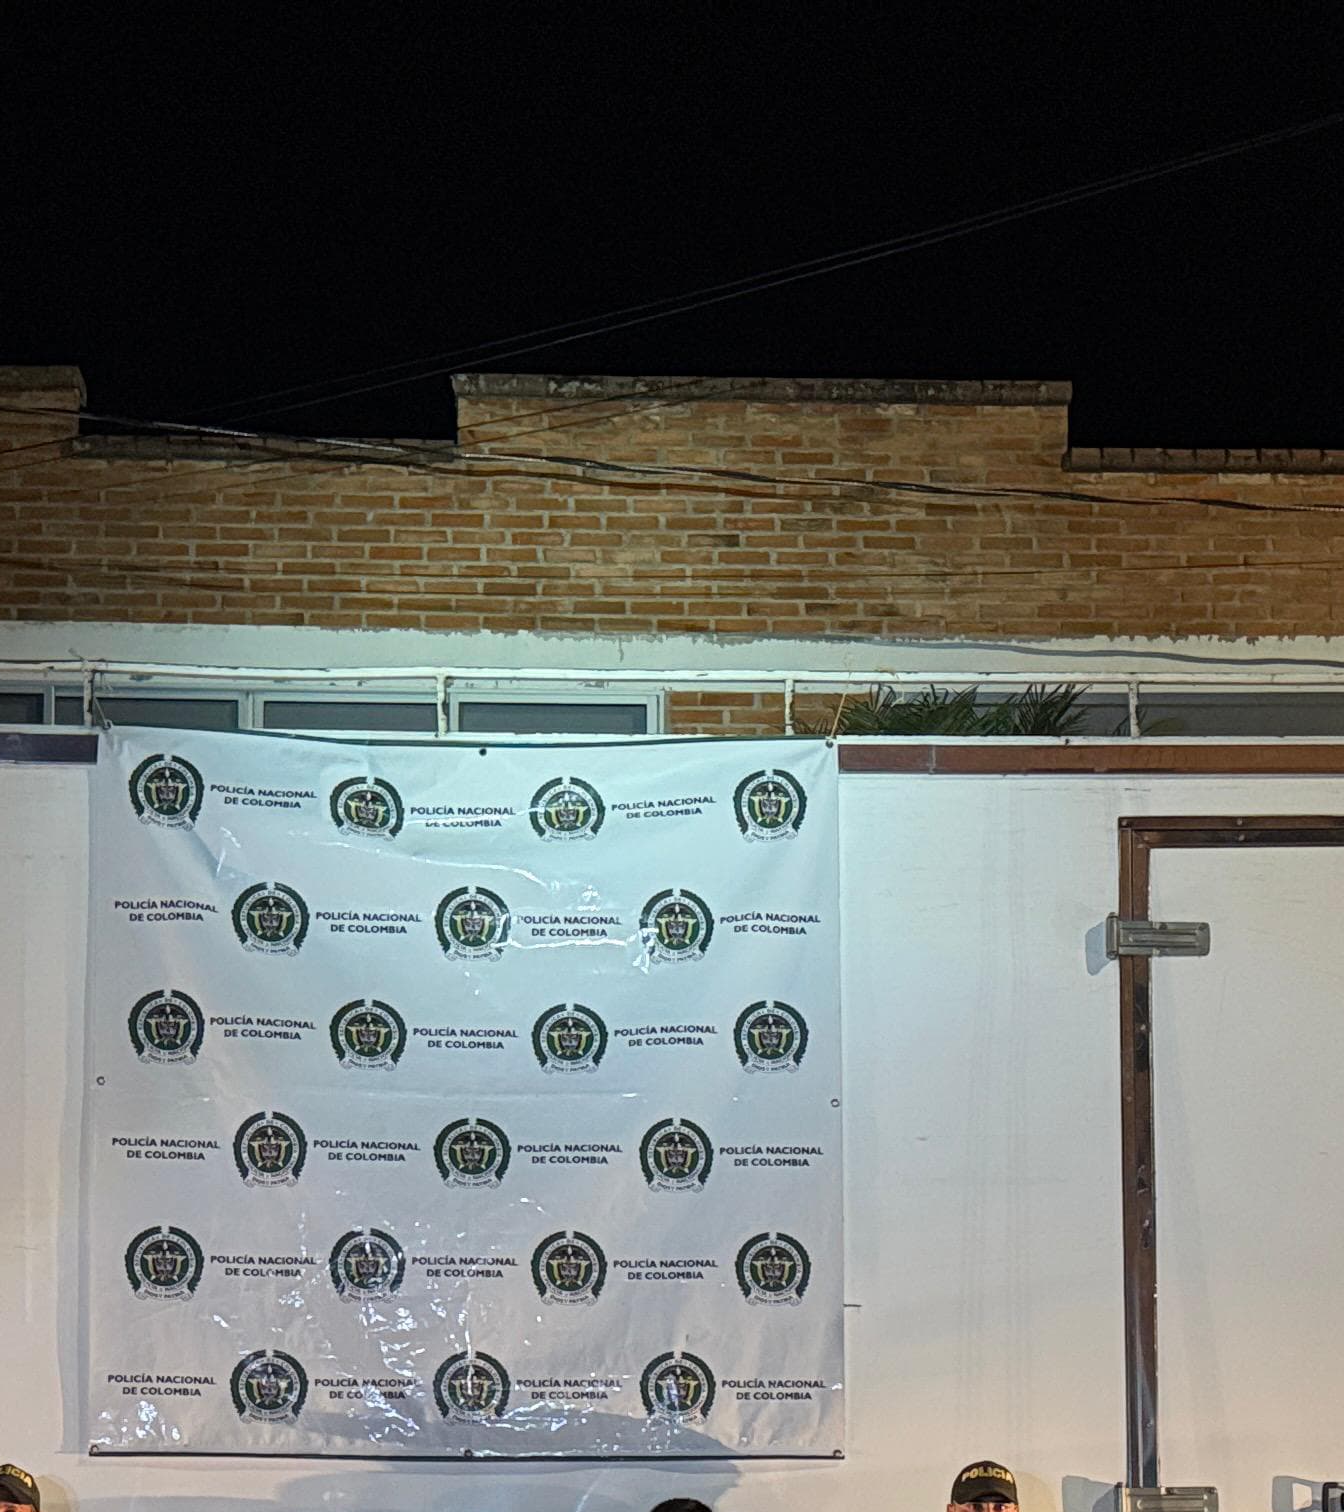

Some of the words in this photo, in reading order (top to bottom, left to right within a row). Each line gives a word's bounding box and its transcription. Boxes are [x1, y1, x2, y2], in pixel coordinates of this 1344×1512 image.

[210, 784, 255, 797] POLICÍA
[258, 789, 317, 799] NACIONAL
[224, 796, 239, 805] DE
[241, 797, 301, 808] COLOMBIA
[612, 800, 655, 810] POLICÍA
[658, 796, 717, 807] NACIONAL
[411, 805, 455, 815] POLICÍA
[457, 807, 516, 816] NACIONAL
[626, 811, 641, 820] DE
[643, 808, 702, 818] COLOMBIA
[115, 898, 158, 910] POLICÍA
[160, 900, 219, 913] NACIONAL
[129, 913, 144, 922] DE
[146, 913, 203, 921] COLOMBIA
[316, 909, 360, 921] POLICÍA
[363, 913, 422, 922] NACIONAL
[564, 915, 622, 925] NACIONAL
[720, 912, 763, 924] POLICÍA
[766, 913, 821, 923] NACIONAL
[331, 924, 345, 933] DE
[348, 925, 407, 934] COLOMBIA
[531, 928, 546, 937] DE
[549, 928, 608, 937] COLOMBIA
[734, 924, 748, 933] DE
[751, 925, 806, 935] COLOMBIA
[210, 1015, 254, 1027] POLICÍA
[256, 1018, 316, 1030] NACIONAL
[224, 1029, 238, 1037] DE
[241, 1029, 301, 1040] COLOMBIA
[413, 1027, 457, 1037] POLICÍA
[460, 1029, 518, 1038] NACIONAL
[614, 1025, 658, 1036] POLICÍA
[661, 1025, 718, 1034] NACIONAL
[427, 1040, 442, 1049] DE
[445, 1040, 504, 1049] COLOMBIA
[628, 1038, 643, 1047] DE
[645, 1037, 704, 1046] COLOMBIA
[112, 1136, 157, 1147] POLICÍA
[160, 1140, 220, 1149] NACIONAL
[313, 1138, 358, 1149] POLICÍA
[361, 1141, 420, 1151] NACIONAL
[517, 1142, 561, 1153] POLICÍA
[564, 1144, 623, 1153] NACIONAL
[126, 1150, 142, 1159] DE
[144, 1151, 205, 1160] COLOMBIA
[719, 1144, 763, 1156] POLICÍA
[766, 1146, 824, 1156] NACIONAL
[328, 1152, 343, 1161] DE
[345, 1152, 406, 1162] COLOMBIA
[531, 1155, 546, 1164] DE
[549, 1155, 608, 1165] COLOMBIA
[734, 1157, 749, 1167] DE
[751, 1158, 809, 1167] COLOMBIA
[211, 1254, 255, 1264] POLICÍA
[258, 1257, 317, 1265] NACIONAL
[412, 1255, 456, 1266] POLICÍA
[459, 1257, 518, 1266] NACIONAL
[613, 1258, 657, 1269] POLICÍA
[660, 1260, 718, 1268] NACIONAL
[225, 1268, 240, 1276] DE
[426, 1269, 441, 1277] DE
[444, 1269, 504, 1278] COLOMBIA
[627, 1271, 642, 1280] DE
[645, 1271, 704, 1280] COLOMBIA
[108, 1373, 153, 1384] POLICÍA
[156, 1375, 216, 1385] NACIONAL
[315, 1378, 358, 1387] POLICÍA
[517, 1377, 561, 1388] POLICÍA
[564, 1380, 622, 1388] NACIONAL
[722, 1378, 766, 1388] POLICÍA
[769, 1380, 826, 1389] NACIONAL
[122, 1386, 137, 1395] DE
[140, 1387, 201, 1396] COLOMBIA
[329, 1390, 344, 1399] DE
[347, 1391, 406, 1400] COMBIA
[531, 1391, 546, 1400] DE
[549, 1391, 608, 1400] COLOMBIA
[736, 1391, 750, 1400] DE
[753, 1392, 812, 1401] COLOMBIA
